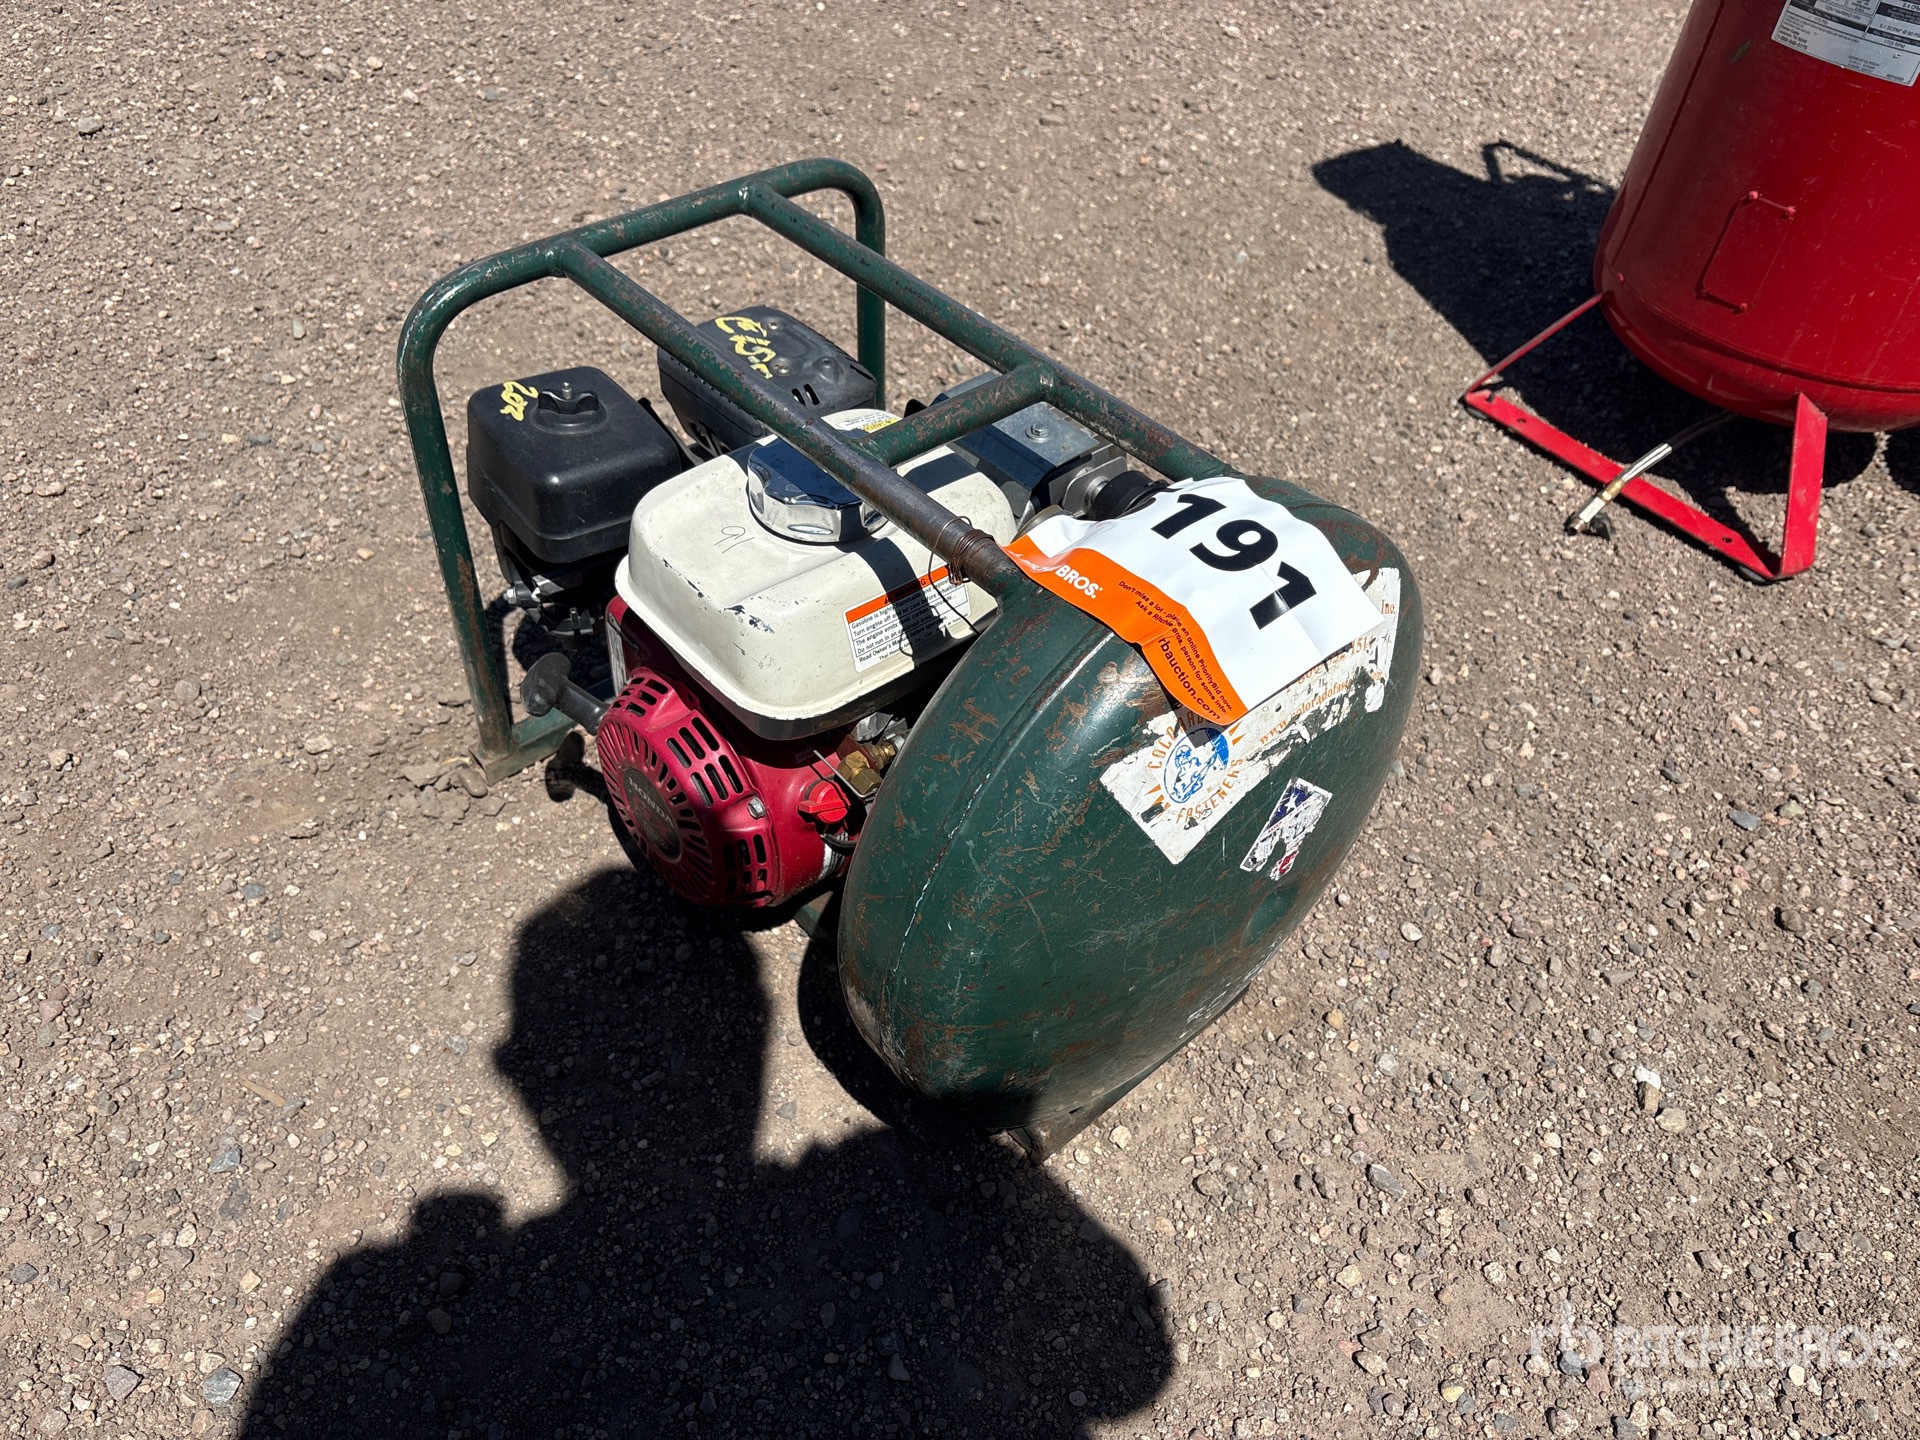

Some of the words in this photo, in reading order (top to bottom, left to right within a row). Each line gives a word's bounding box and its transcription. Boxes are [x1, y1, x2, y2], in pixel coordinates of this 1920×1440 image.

[1151, 494, 1317, 630] 191
[851, 615, 874, 629] Gasoline
[853, 628, 866, 637] Turn
[865, 620, 884, 632] engine
[856, 638, 865, 646] The
[866, 630, 884, 642] engine
[884, 622, 898, 632] emits
[911, 607, 929, 619] carbon
[1119, 581, 1136, 593] Don't
[1135, 590, 1149, 602] miss
[1154, 603, 1164, 613] lot
[1181, 626, 1190, 637] an
[1187, 637, 1200, 659] online
[1199, 658, 1221, 695] PriorityBid
[859, 654, 872, 663] Read
[872, 643, 892, 656] Owner's
[865, 642, 874, 650] not
[1135, 600, 1148, 612] Ask
[1152, 613, 1173, 627] Ritchie
[1181, 645, 1197, 671] person
[1194, 670, 1203, 681] for
[1201, 682, 1216, 701] some
[1158, 637, 1221, 720] rbauction.com
[629, 776, 676, 829] HONDA
